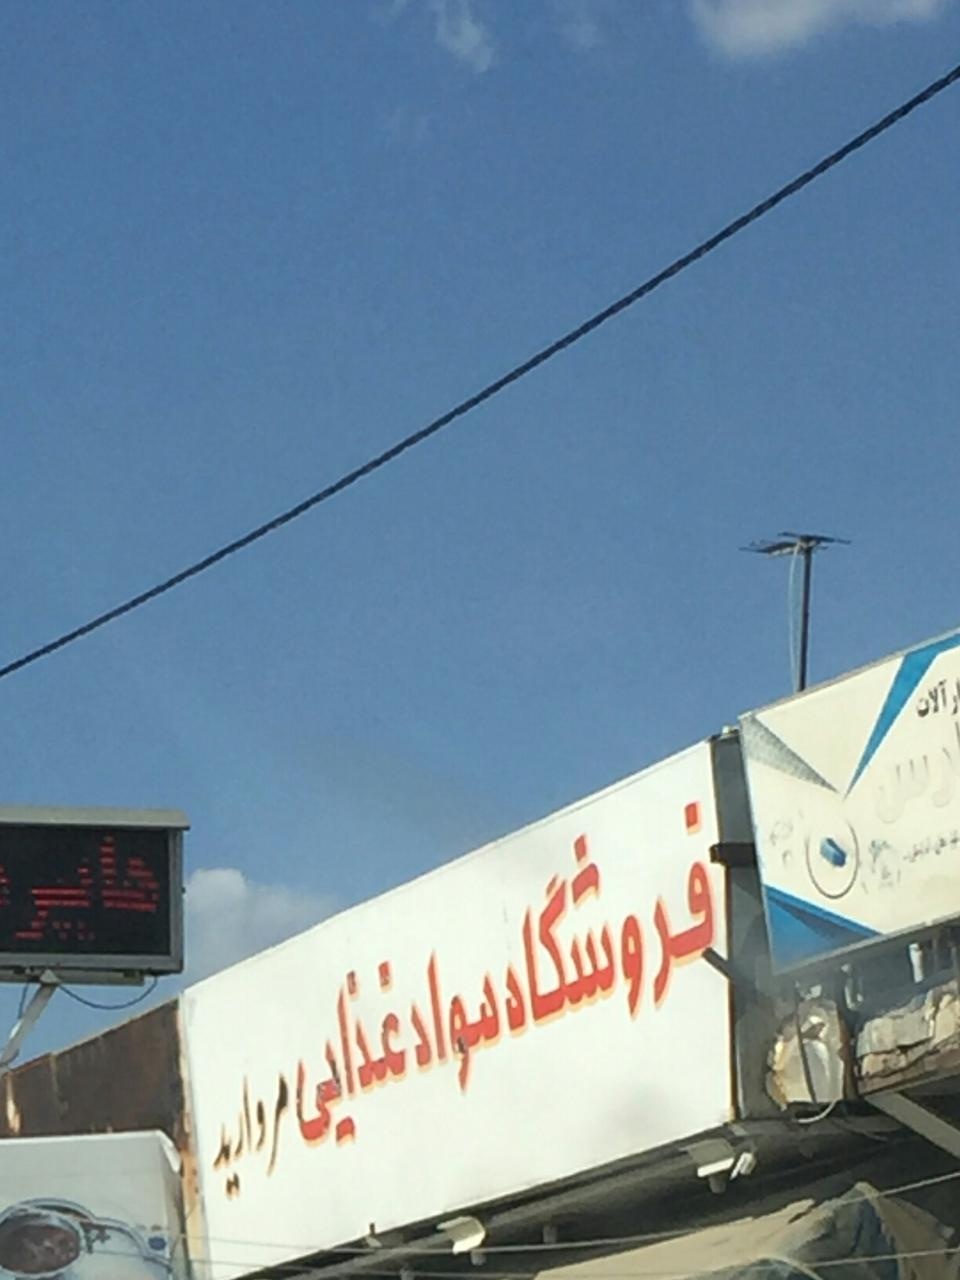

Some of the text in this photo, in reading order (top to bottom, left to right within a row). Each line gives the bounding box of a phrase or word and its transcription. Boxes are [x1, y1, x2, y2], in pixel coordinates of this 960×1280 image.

[213, 802, 714, 1196] فروشگاه مواد غذایی مروارید
